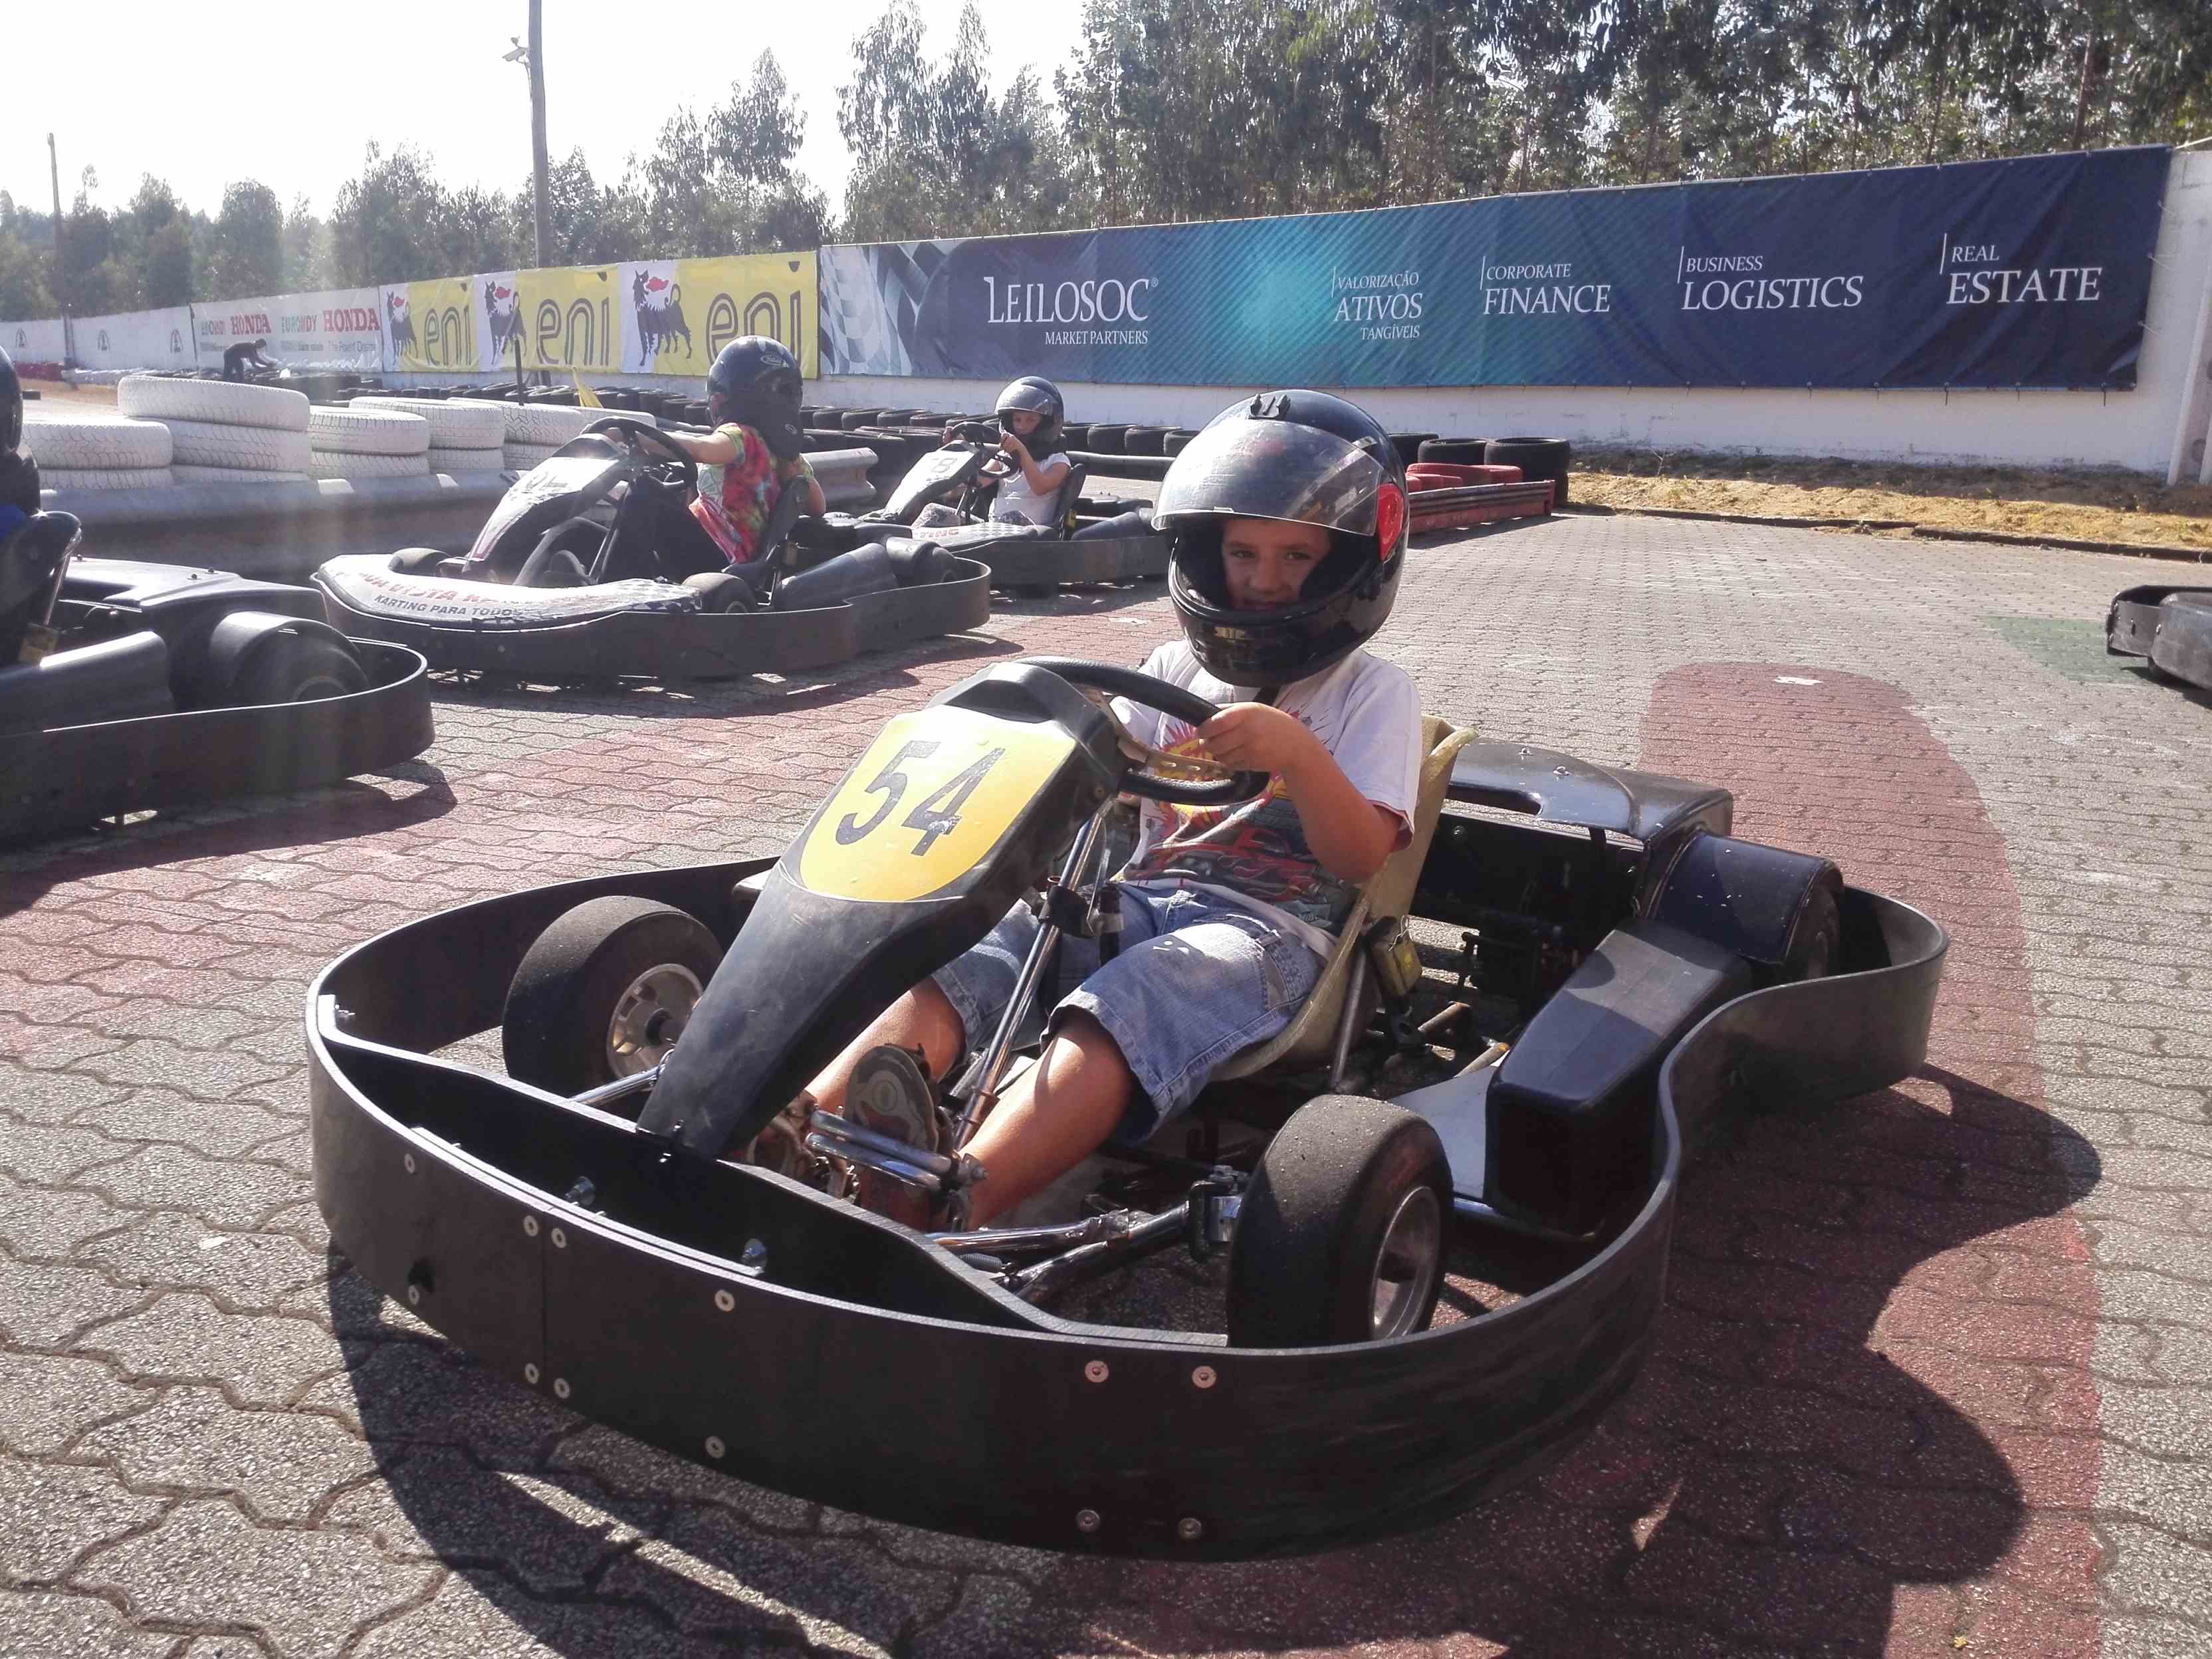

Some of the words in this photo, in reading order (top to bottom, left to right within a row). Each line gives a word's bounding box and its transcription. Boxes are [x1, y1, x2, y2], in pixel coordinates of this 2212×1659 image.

[1686, 255, 1763, 273] BUSINESS
[1951, 245, 2000, 263] REAL
[1338, 271, 1419, 290] VALORIZAÇÃO
[1486, 263, 1571, 280] CORPORATE
[1681, 276, 1864, 310] LOGISTICS
[1946, 267, 2102, 304] ESTATE
[1333, 292, 1424, 322] ATIVOS
[1484, 284, 1611, 315] FINANCE
[231, 314, 272, 335] HONDA
[322, 308, 380, 332] HONDA
[424, 282, 472, 366] eni
[537, 271, 610, 366] eni
[705, 261, 802, 366] eni
[1045, 332, 1088, 345] MARKET
[1090, 330, 1149, 344] PARTNERS
[1361, 324, 1420, 340] TANGÍVEIS
[374, 594, 427, 612] KARTING
[430, 604, 467, 615] PARA
[835, 740, 1006, 856] 54
